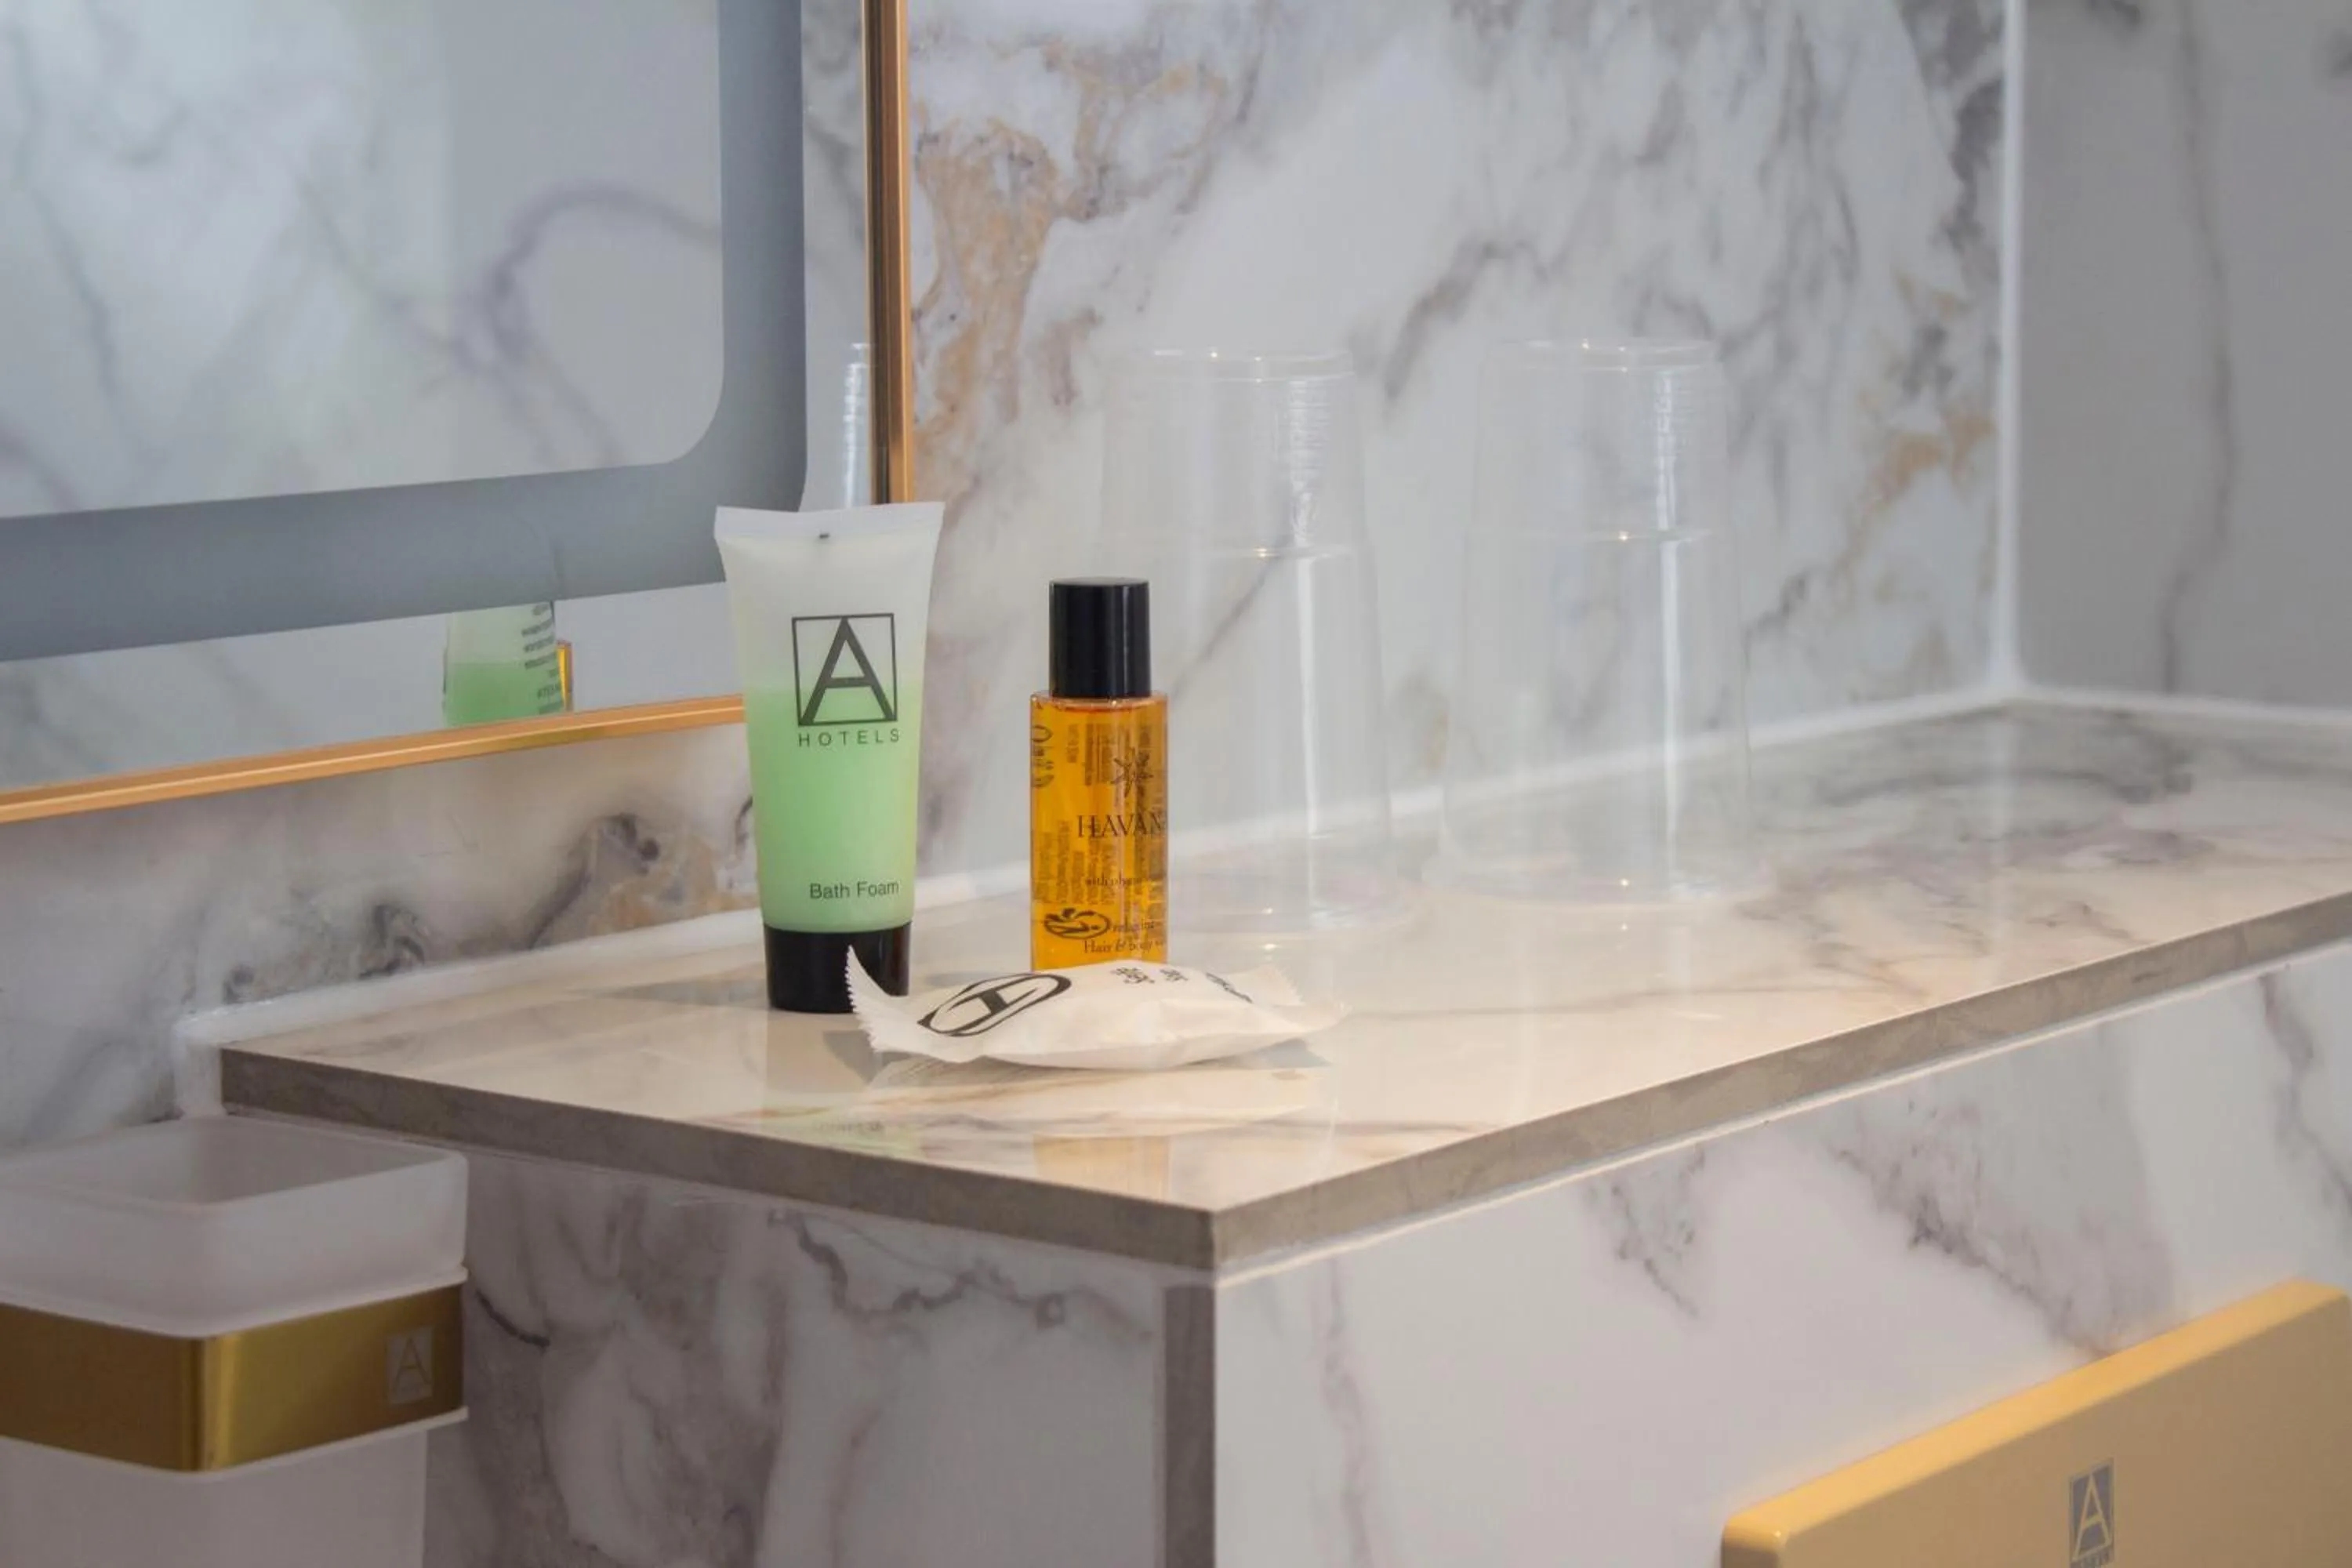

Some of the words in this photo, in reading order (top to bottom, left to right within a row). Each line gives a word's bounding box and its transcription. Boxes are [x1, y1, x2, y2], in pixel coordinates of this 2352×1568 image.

[800, 613, 895, 726] A
[797, 728, 900, 747] HOTELS
[809, 882, 851, 899] Bath
[856, 880, 900, 898] Foam
[1084, 939, 1112, 954] Hair
[2071, 1470, 2112, 1562] A
